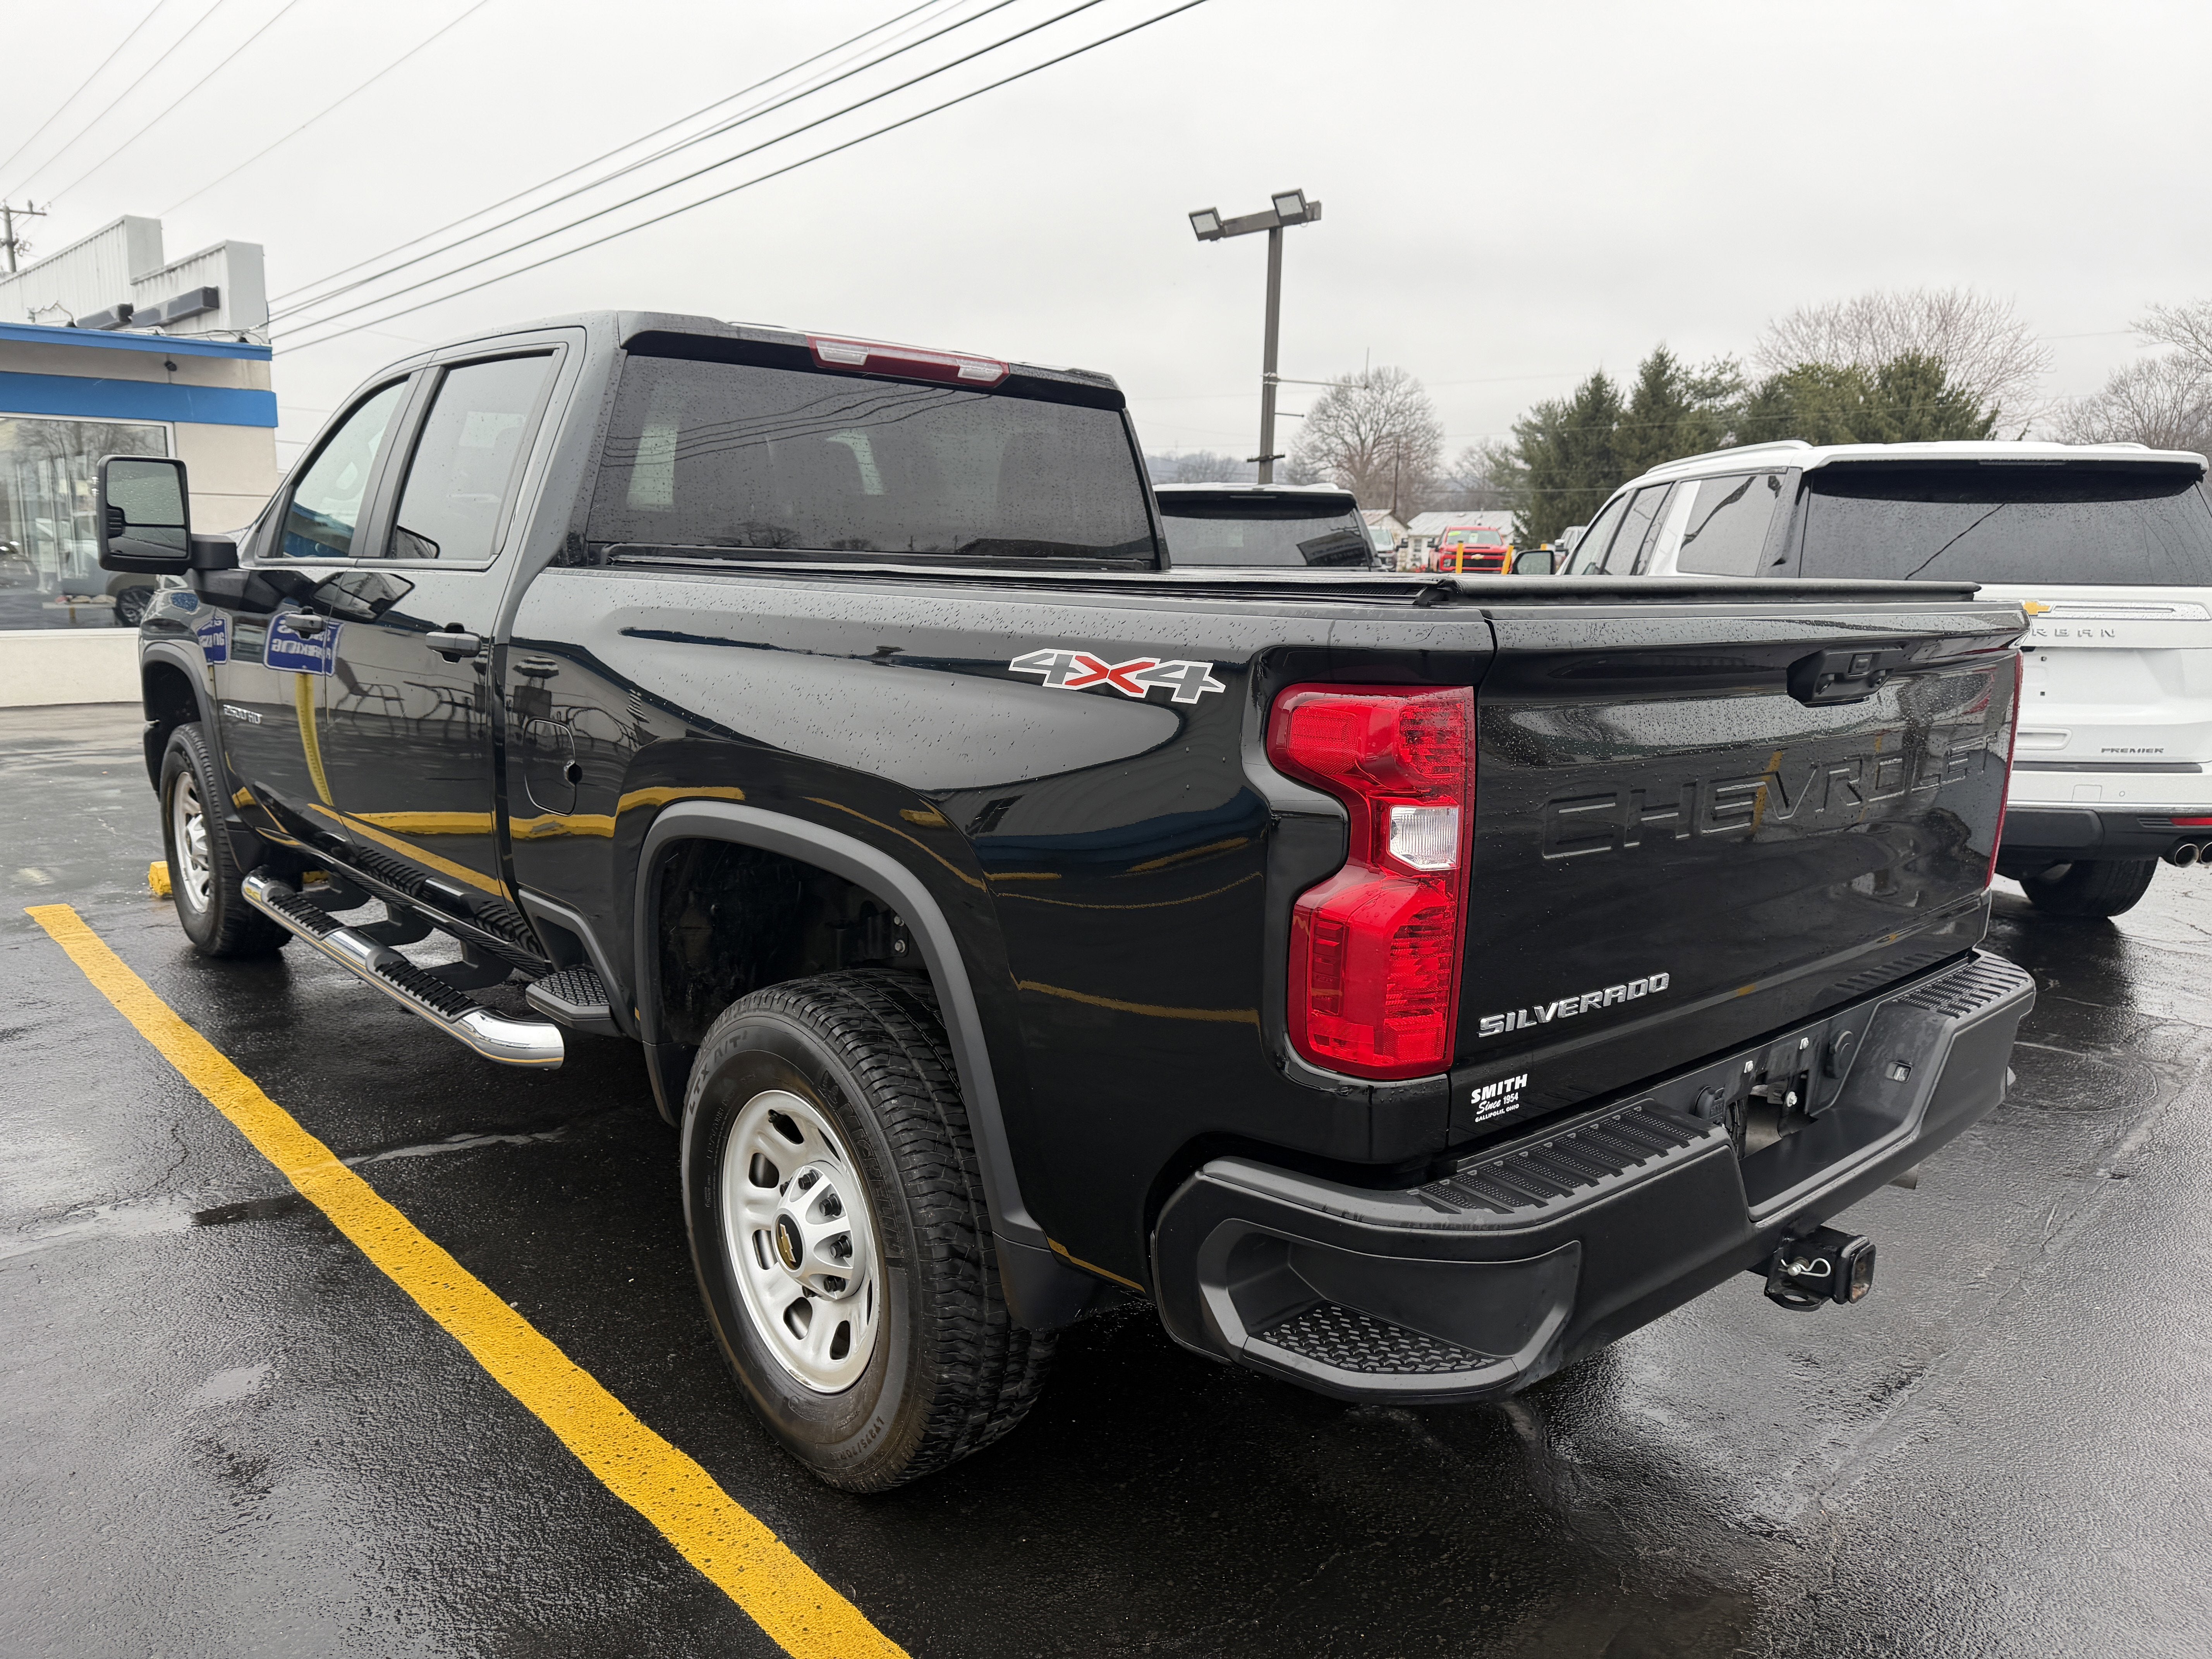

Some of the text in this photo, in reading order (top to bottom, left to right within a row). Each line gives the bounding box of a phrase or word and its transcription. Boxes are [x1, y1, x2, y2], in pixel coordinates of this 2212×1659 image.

[2032, 628, 2116, 638] RBAN
[1543, 731, 1997, 859] CHEVROLET
[1477, 972, 1669, 1038] SILVERADO
[1471, 1073, 1528, 1104] SMITH
[1476, 1092, 1518, 1115] Since 1954
[1506, 1104, 1519, 1112] OHIO
[838, 1102, 905, 1258] MICHELIN
